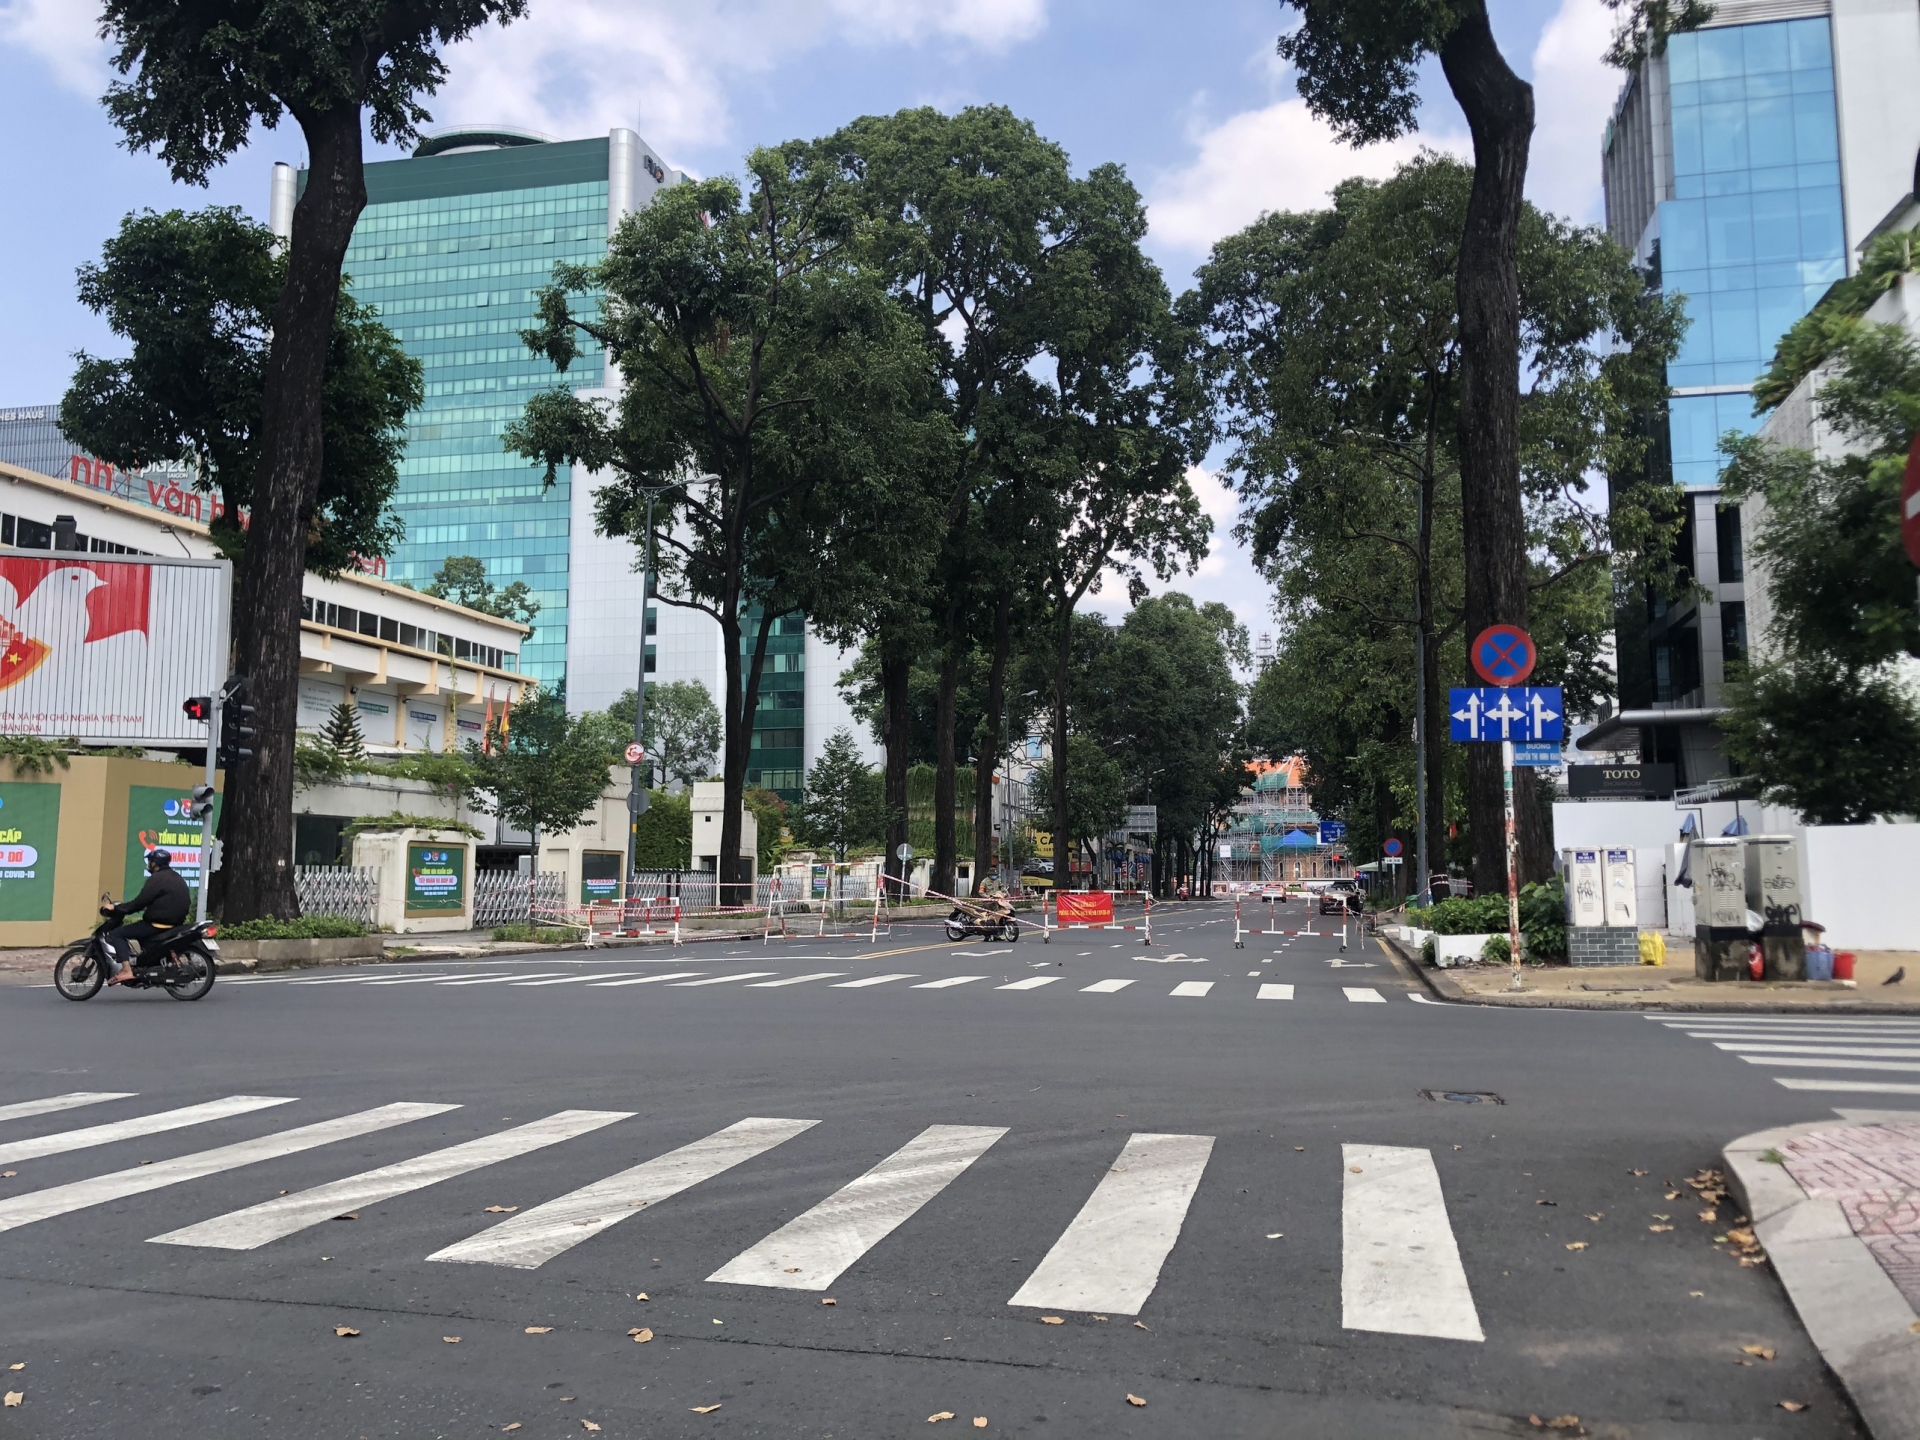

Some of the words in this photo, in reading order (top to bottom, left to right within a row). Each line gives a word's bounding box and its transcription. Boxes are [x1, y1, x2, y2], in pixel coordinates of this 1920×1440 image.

[19, 410, 45, 420] HAUS
[147, 479, 201, 523] văn
[102, 713, 121, 723] VIỆT
[123, 715, 142, 723] NAM
[1602, 769, 1641, 779] TOTO
[0, 828, 22, 843] CẤP
[159, 829, 177, 845] TỔNG
[178, 832, 190, 845] ĐÀI
[8, 849, 24, 862] ĐỠ
[188, 852, 196, 863] VÀ
[4, 870, 35, 878] COVID-19
